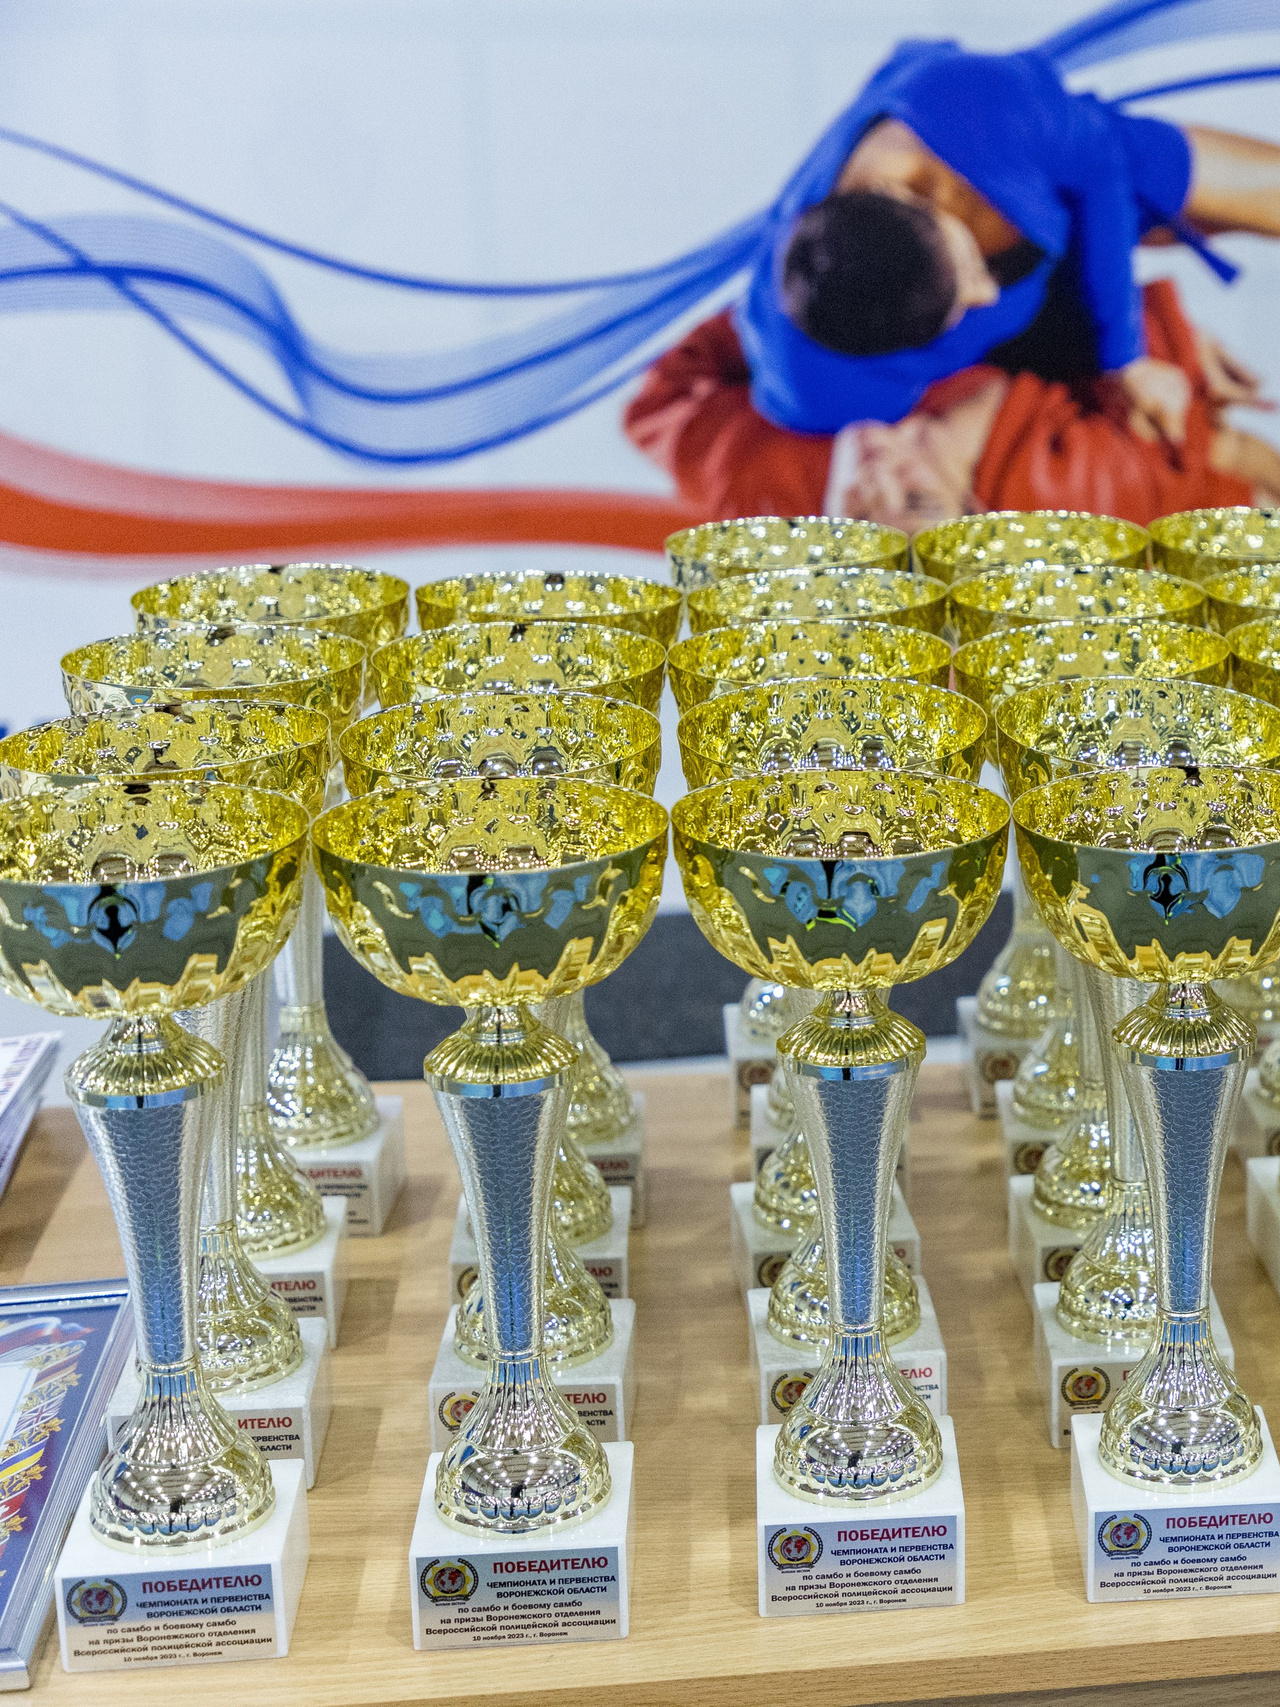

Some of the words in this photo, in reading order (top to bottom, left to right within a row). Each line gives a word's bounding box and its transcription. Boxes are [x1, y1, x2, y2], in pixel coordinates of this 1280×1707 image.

[1166, 1512, 1273, 1529] ПОБЕДИТЕЛЮ
[838, 1525, 947, 1542] ПОБЕДИТЕЛЮ
[1159, 1534, 1215, 1543] ЧЕМПИОНАТА
[1225, 1531, 1280, 1540] ПЕРВЕНСТВА
[831, 1547, 888, 1556] ЧЕМПИОНАТА
[899, 1543, 954, 1553] ПЕРВЕНСТВА
[1168, 1542, 1231, 1553] ВОРОНЕЖСКОЙ
[1233, 1541, 1271, 1549] ОБЛАСТИ
[493, 1556, 608, 1574] ПОБЕДИТЕЛЮ
[840, 1555, 905, 1566] ВОРОНЕЖСКОЙ
[907, 1554, 945, 1562] ОБЛАСТИ
[1143, 1558, 1171, 1566] самбо
[1219, 1554, 1247, 1562] самбо
[815, 1572, 844, 1580] самбо
[853, 1570, 891, 1578] боевому
[893, 1567, 922, 1575] самбо
[1127, 1570, 1154, 1578] призы
[1156, 1566, 1218, 1576] Воронежского
[1220, 1564, 1263, 1572] отделения
[142, 1574, 262, 1594] ПОБЕДИТЕЛЮ
[486, 1579, 547, 1588] ЧЕМПИОНАТА
[558, 1575, 616, 1585] ПЕРВЕНСТВА
[829, 1580, 892, 1589] Воронежского
[894, 1577, 938, 1585] отделения
[1100, 1577, 1166, 1588] Всероссийской
[1168, 1574, 1224, 1584] полицейской
[1226, 1573, 1277, 1581] ассоциации
[496, 1587, 565, 1598] ВОРОНЕЖСКОЙ
[567, 1586, 607, 1595] ОБЛАСТИ
[771, 1591, 839, 1602] Всероссийской
[841, 1587, 898, 1597] полицейской
[900, 1586, 953, 1594] ассоциации
[136, 1598, 199, 1608] ЧЕМПИОНАТА
[210, 1593, 271, 1604] ПЕРВЕНСТВА
[471, 1604, 501, 1613] самбо
[553, 1600, 583, 1608] самбо
[146, 1606, 218, 1619] ВОРОНЕЖСКОЙ
[220, 1604, 262, 1614] ОБЛАСТИ
[486, 1612, 552, 1622] Воронежского
[554, 1610, 601, 1618] отделения
[120, 1625, 152, 1633] самбо
[206, 1619, 237, 1628] самбо
[425, 1624, 497, 1635] Всероссийской
[499, 1620, 559, 1631] полицейской
[561, 1619, 616, 1627] ассоциации
[103, 1637, 134, 1646] призы
[136, 1632, 206, 1643] Воронежского
[208, 1629, 256, 1637] отделения
[73, 1644, 148, 1657] Всероссийской
[151, 1640, 213, 1651] полицейской
[215, 1638, 272, 1647] ассоциации
